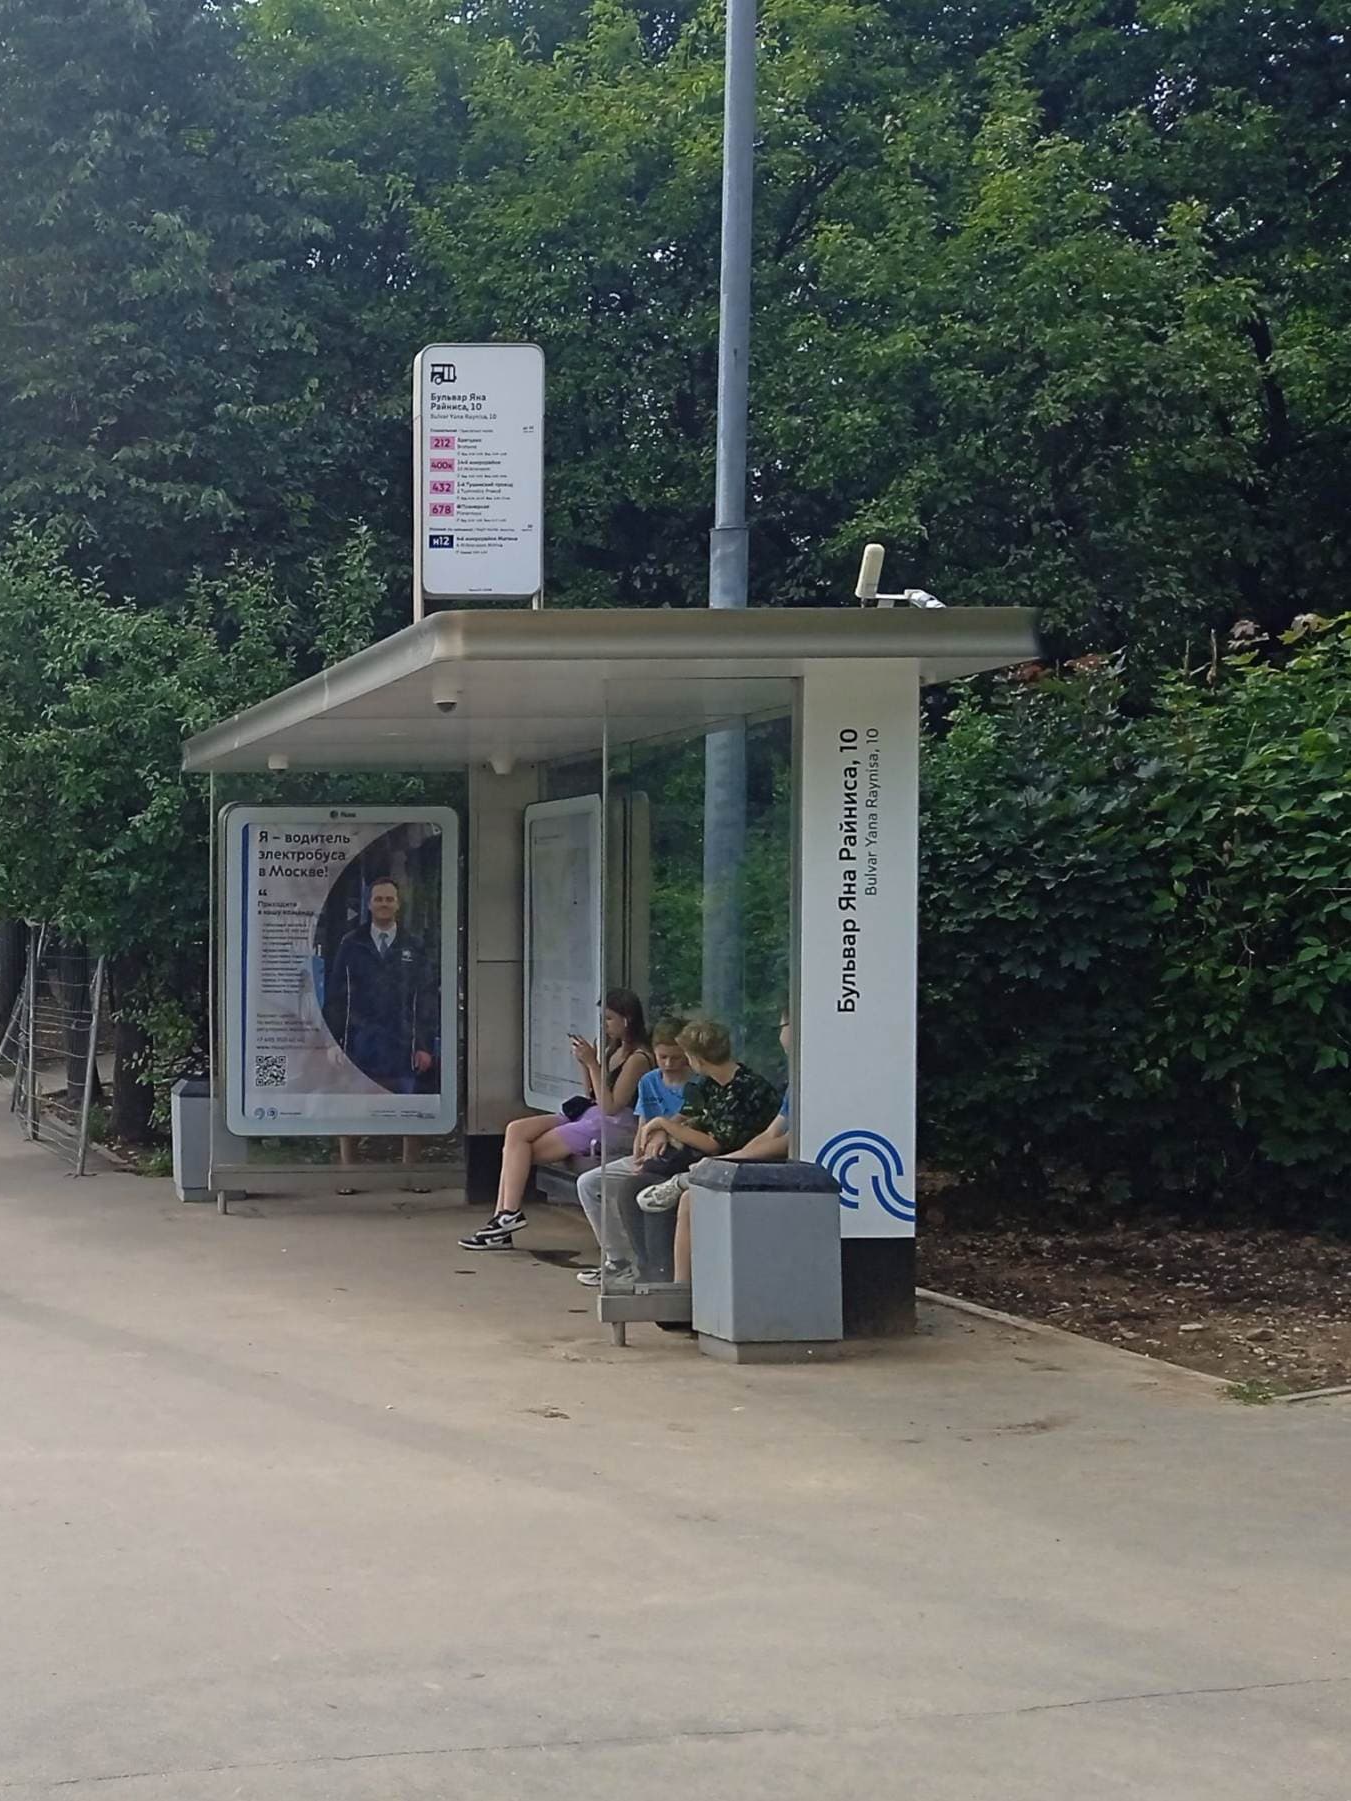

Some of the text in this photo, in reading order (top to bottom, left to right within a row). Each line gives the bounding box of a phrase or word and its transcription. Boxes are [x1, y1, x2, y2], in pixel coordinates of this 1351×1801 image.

[430, 392, 487, 403] Бульвар Яна
[430, 402, 482, 411] Райниса, 10
[433, 438, 451, 448] 212
[432, 483, 452, 493] 432
[432, 505, 452, 514] 678
[865, 727, 881, 896] Bulvar Yana Raynisa, 10
[258, 830, 269, 843] Я
[285, 833, 351, 845] водитель
[258, 848, 346, 863] электробуса
[258, 865, 329, 878] в Москве!
[837, 728, 861, 1013] Бульвар Яна Райниса, 10
